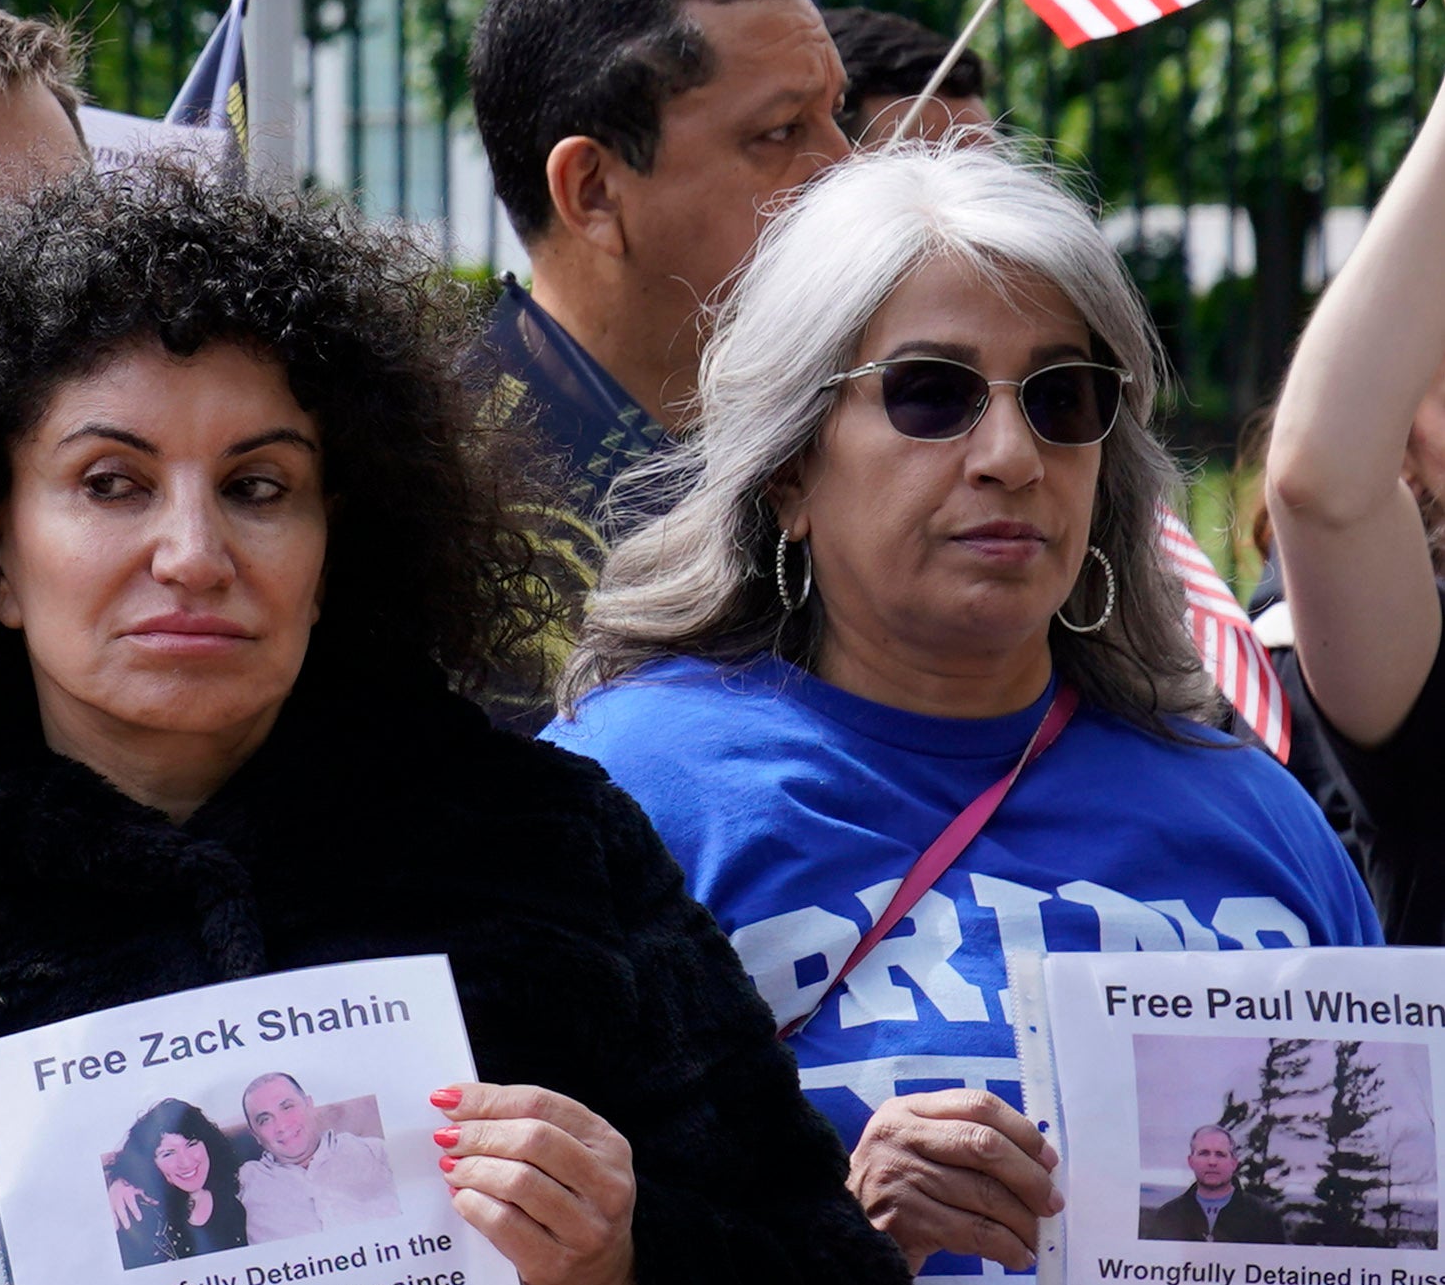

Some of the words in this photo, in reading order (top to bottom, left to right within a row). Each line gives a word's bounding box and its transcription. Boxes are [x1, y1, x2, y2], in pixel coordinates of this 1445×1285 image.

[1105, 985, 1193, 1019] Free
[1206, 988, 1293, 1020] Paul
[1305, 990, 1445, 1027] Whelan
[33, 1048, 127, 1092] Free
[139, 1019, 246, 1068] Zack
[257, 995, 411, 1042] Shahin
[374, 1243, 401, 1264] in
[408, 1234, 453, 1257] the
